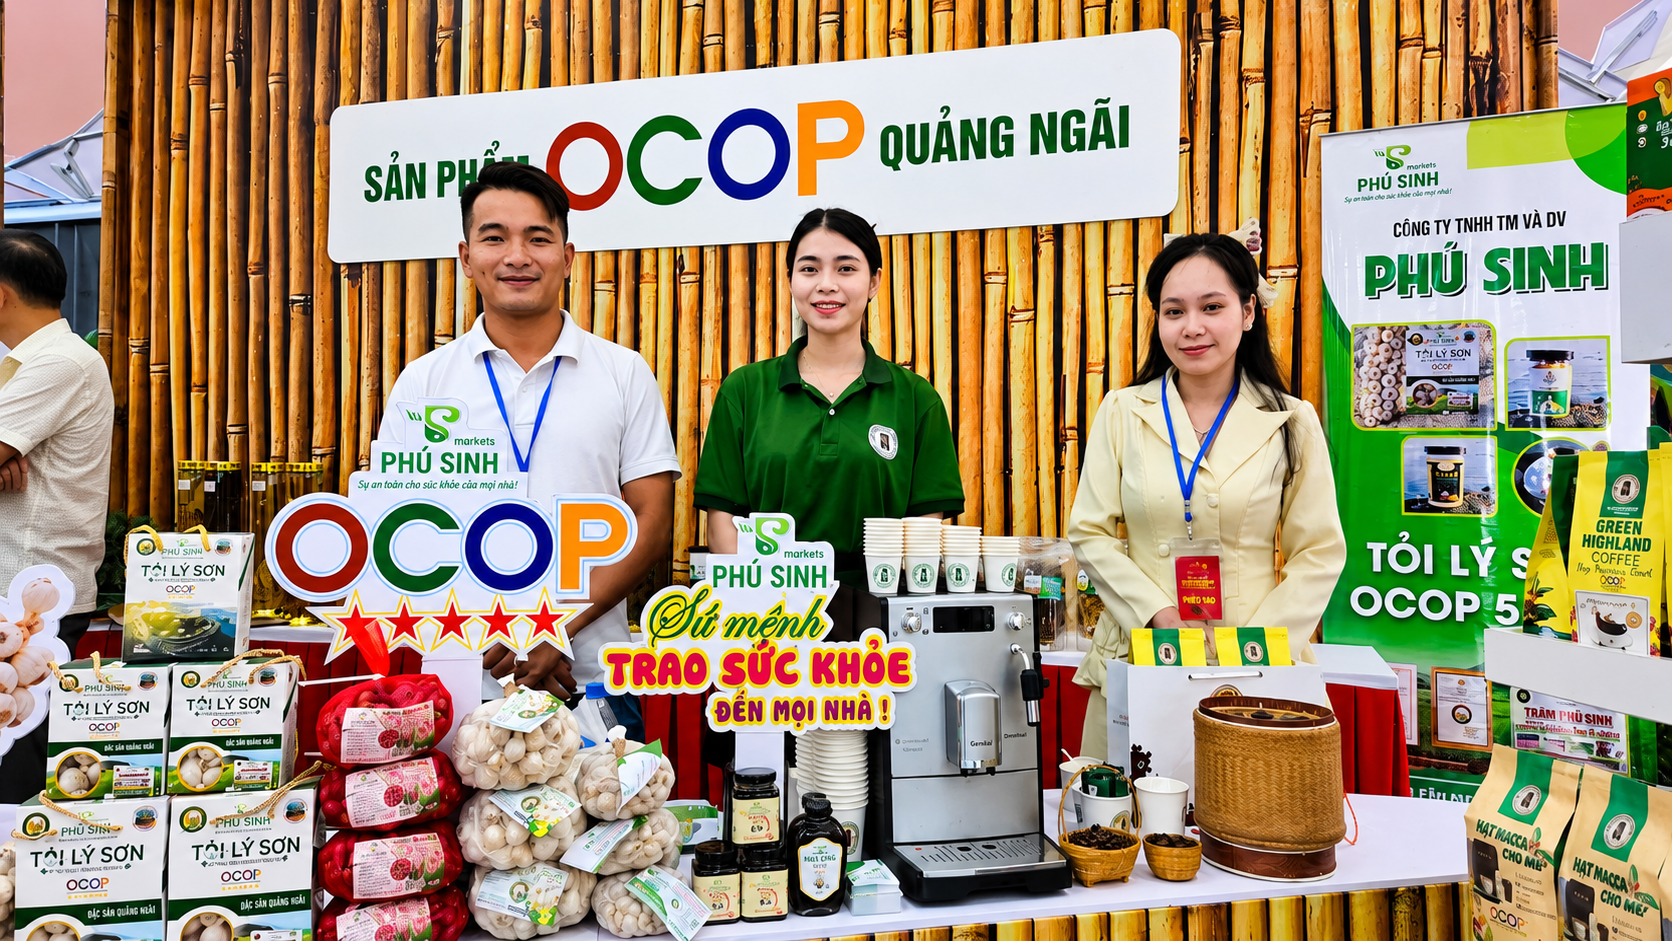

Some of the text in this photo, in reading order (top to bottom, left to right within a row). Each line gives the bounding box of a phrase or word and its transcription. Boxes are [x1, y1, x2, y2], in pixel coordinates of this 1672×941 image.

[364, 97, 1130, 211] SẢN PH OCOP QUẢNG NGÃI
[1407, 162, 1437, 170] markets
[1357, 171, 1439, 192] PHÚ SINH
[1393, 209, 1567, 237] CÔNG TY TNHH TM VÀ DV
[1365, 241, 1608, 299] PHÚ SINH
[454, 436, 495, 446] markets
[381, 445, 498, 474] PHÚ SINH
[371, 481, 382, 489] an
[405, 479, 421, 489] cho
[479, 479, 496, 491] mọi
[1596, 519, 1642, 535] GREEN
[275, 502, 629, 594] OCOP
[1581, 533, 1652, 552] HIGHLAND
[784, 549, 824, 559] markets
[1366, 531, 1433, 575] TỎI
[1451, 536, 1496, 577] LÝ
[1591, 551, 1641, 567] COFFEE
[172, 562, 190, 576] LÝ
[193, 564, 225, 576] SƠN
[713, 558, 827, 588] PHÚ SINH
[166, 585, 195, 593] OCOP
[1350, 585, 1520, 626] OCOP 5
[649, 588, 720, 648] Sứ
[606, 639, 910, 686] TRAO SỨC KHỎE
[95, 699, 113, 715] LÝ
[117, 700, 150, 714] SƠN
[217, 695, 235, 710] LÝ
[238, 697, 270, 709] SƠN
[714, 689, 763, 722] ĐẾN
[773, 700, 814, 727] MỌI
[824, 693, 872, 721] NHÀ
[89, 722, 120, 731] OCOP
[211, 718, 242, 727] OCOP
[1584, 713, 1613, 726] SINH
[244, 816, 271, 826] SINH
[232, 837, 255, 857] LÝ
[259, 836, 300, 855] SƠN
[1495, 827, 1528, 851] MACCA
[72, 844, 96, 865] LÝ
[101, 843, 144, 863] SƠN
[1502, 848, 1522, 865] CHO
[66, 877, 110, 890] OCOP
[221, 868, 262, 882] OCOP
[1593, 865, 1628, 893] MACCA
[1601, 889, 1621, 908] CHO
[1490, 906, 1526, 930] OCOP
